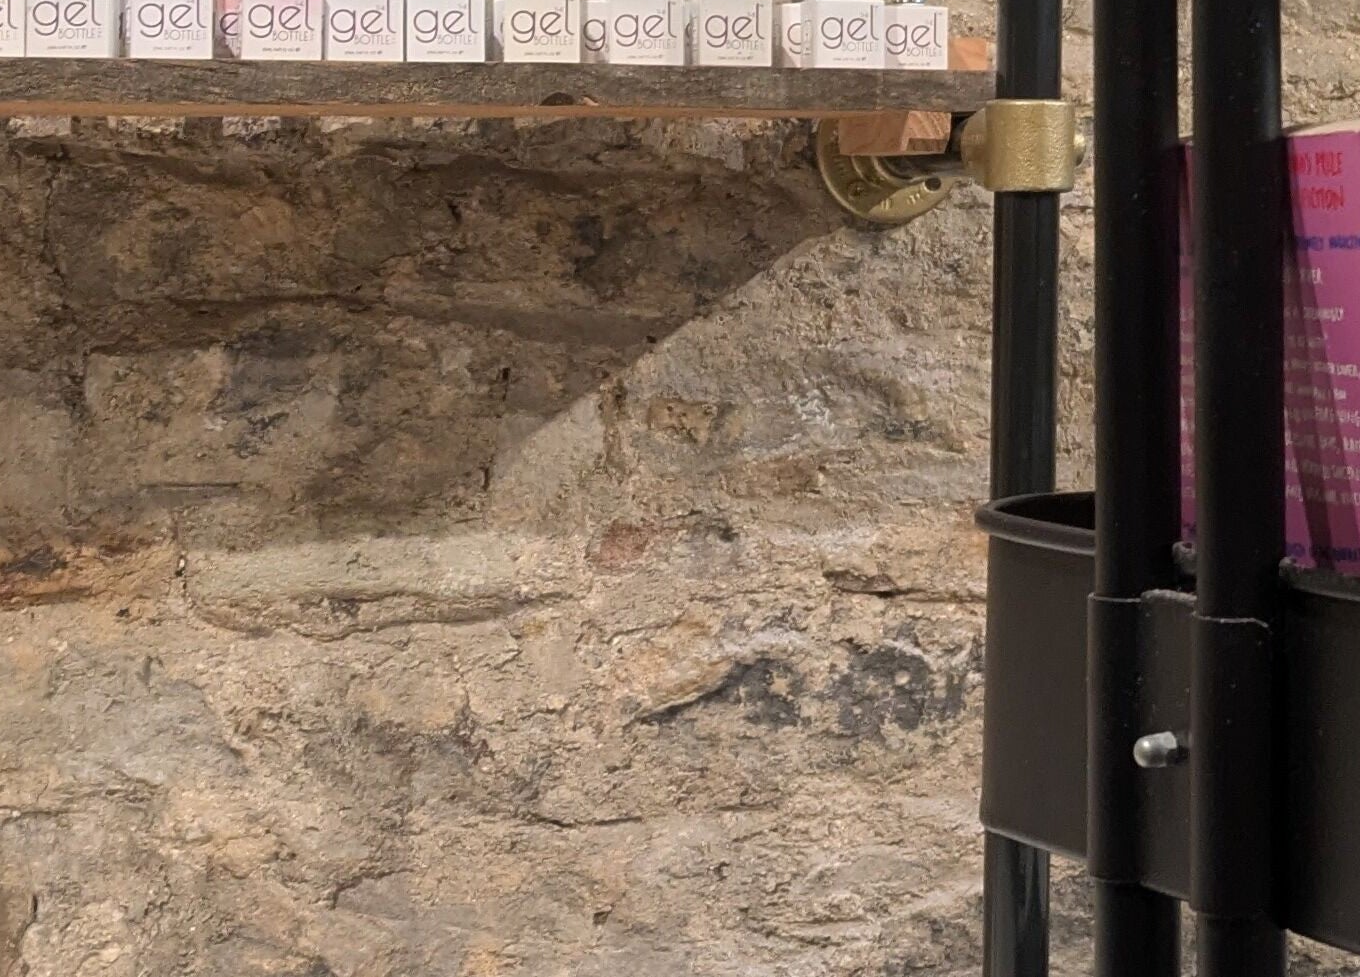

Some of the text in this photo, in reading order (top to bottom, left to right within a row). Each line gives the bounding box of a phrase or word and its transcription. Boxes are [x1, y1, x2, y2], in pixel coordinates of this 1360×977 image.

[615, 0, 677, 47] gel
[705, 3, 765, 48] gel
[821, 4, 879, 50] gel
[886, 12, 941, 55] gel
